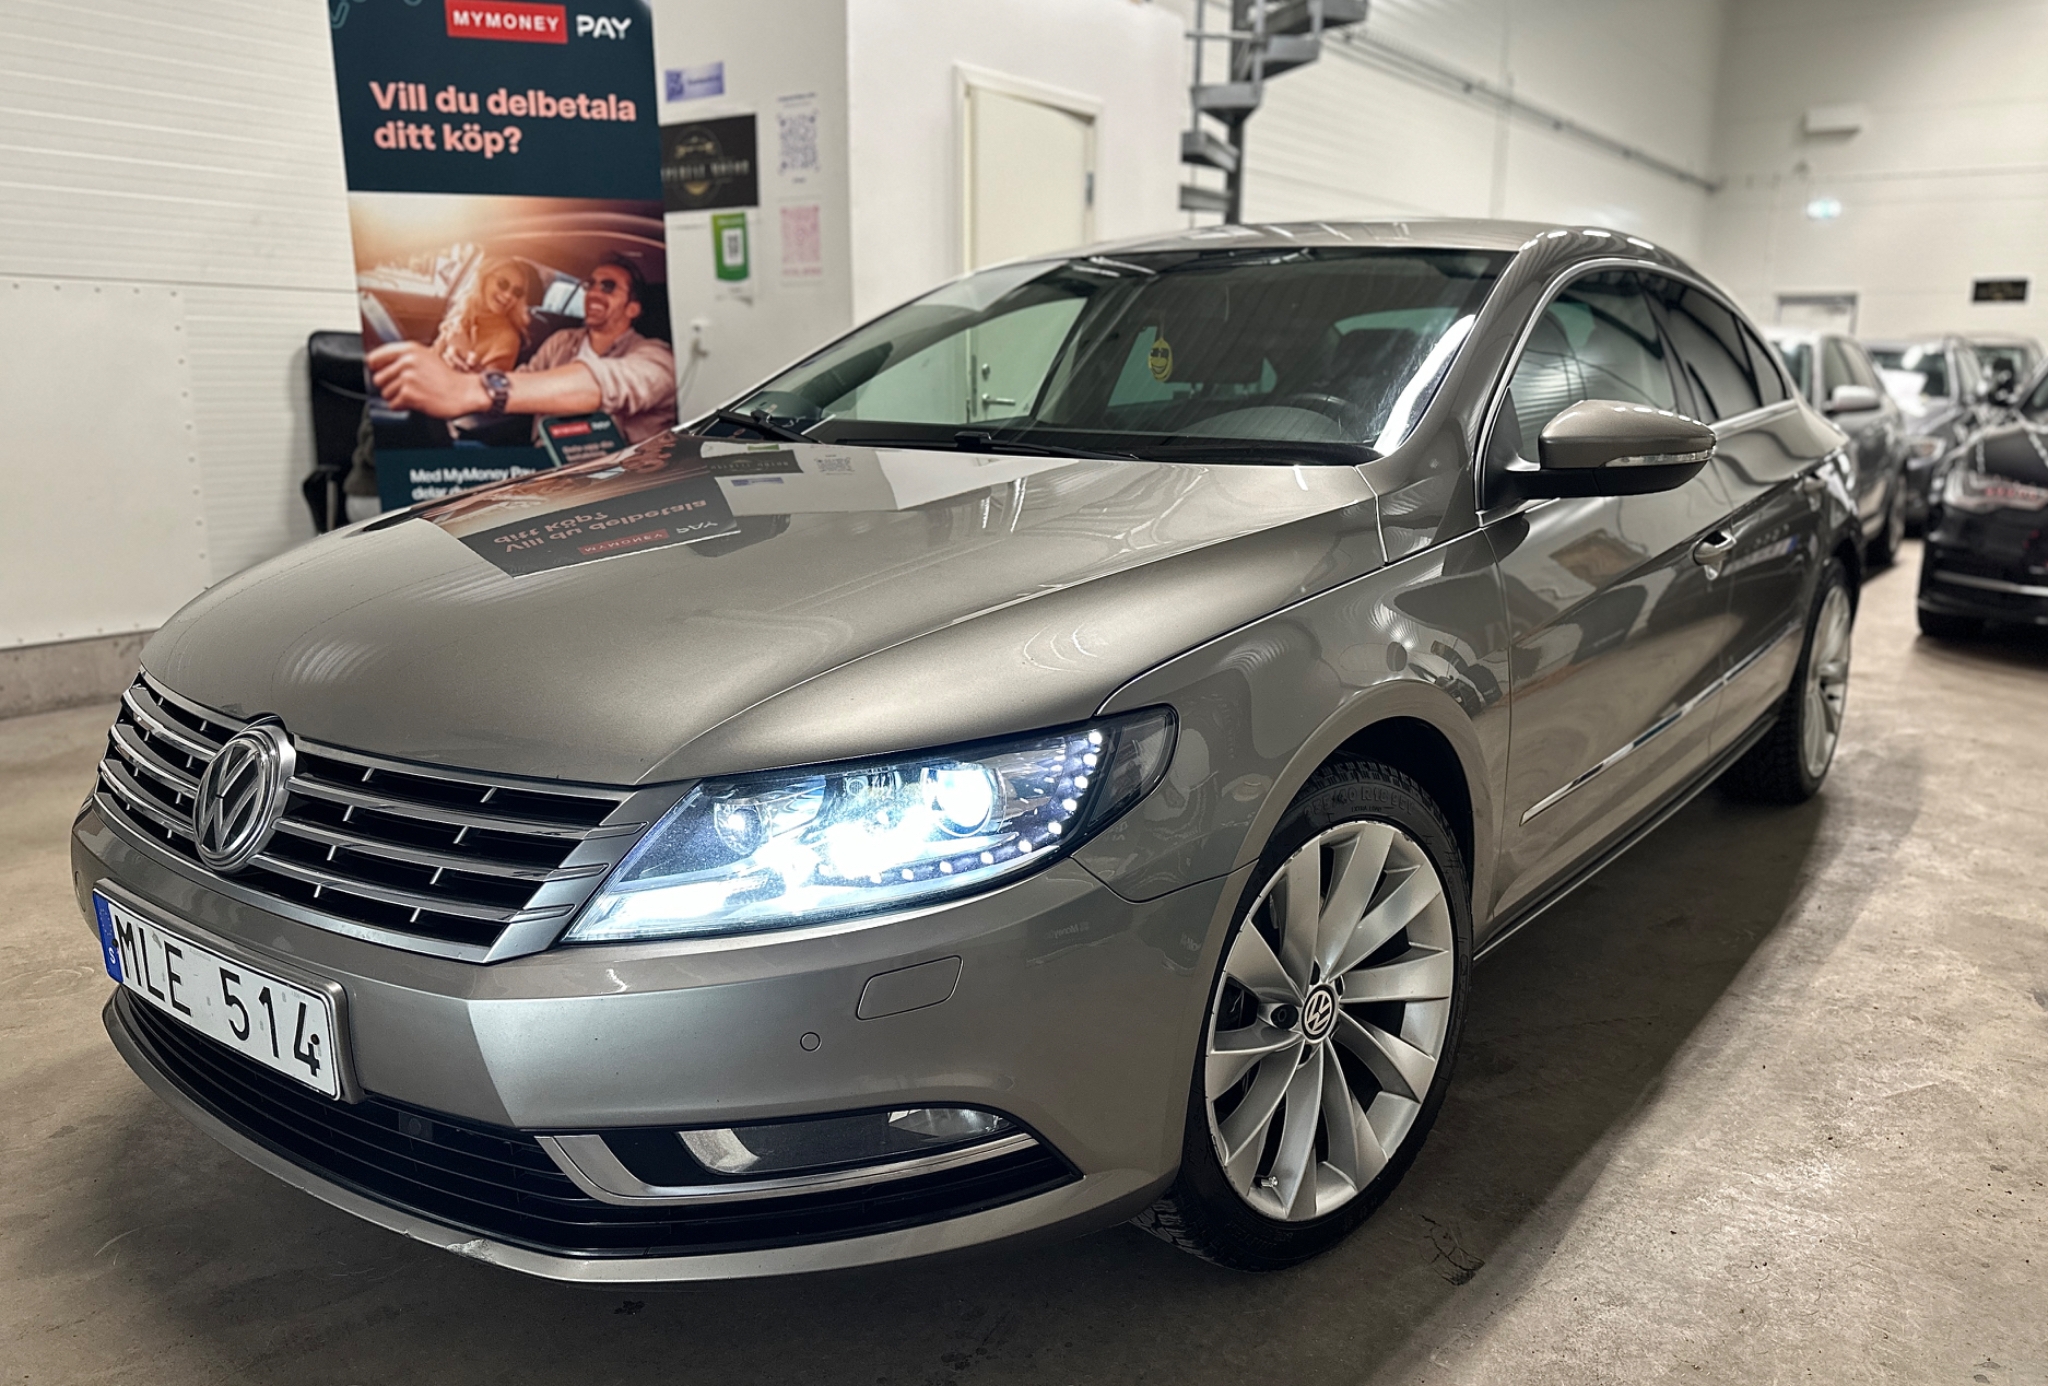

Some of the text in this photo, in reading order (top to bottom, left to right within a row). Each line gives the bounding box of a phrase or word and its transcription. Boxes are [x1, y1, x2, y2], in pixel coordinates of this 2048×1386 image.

[453, 10, 632, 39] MYMONEY PAY
[369, 81, 637, 122] Vill du delbetala
[374, 121, 523, 159] ditt köp?
[410, 467, 442, 483] Med
[443, 467, 509, 484] MyMoney
[108, 946, 116, 965] S
[115, 914, 321, 1077] MLE 514
